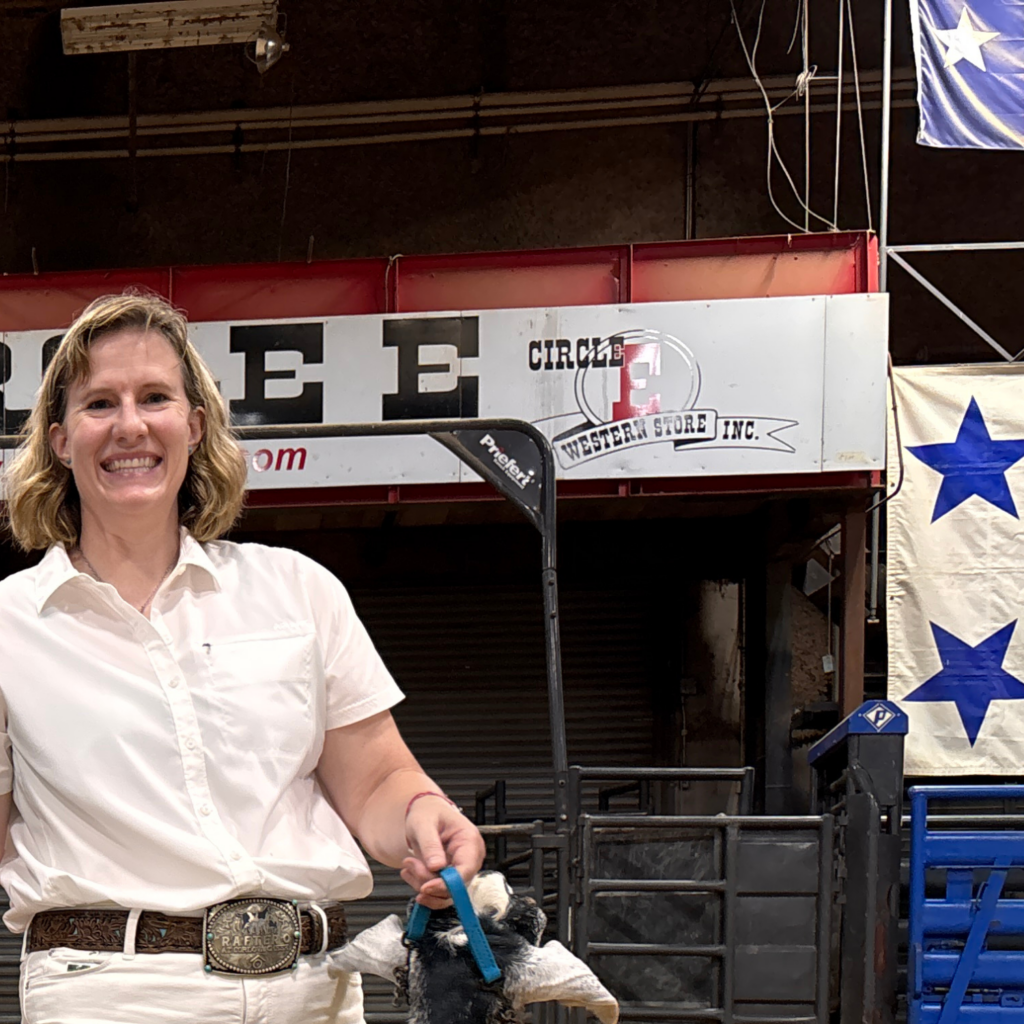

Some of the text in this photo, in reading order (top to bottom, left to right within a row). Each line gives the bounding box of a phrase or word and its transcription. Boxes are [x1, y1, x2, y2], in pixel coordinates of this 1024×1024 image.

[382, 316, 479, 421] E
[528, 337, 624, 371] CIRCLE
[612, 343, 661, 422] E
[479, 434, 532, 487] Priefert
[561, 413, 760, 462] WESTERN STORE INC.
[222, 934, 279, 947] RAFTER
